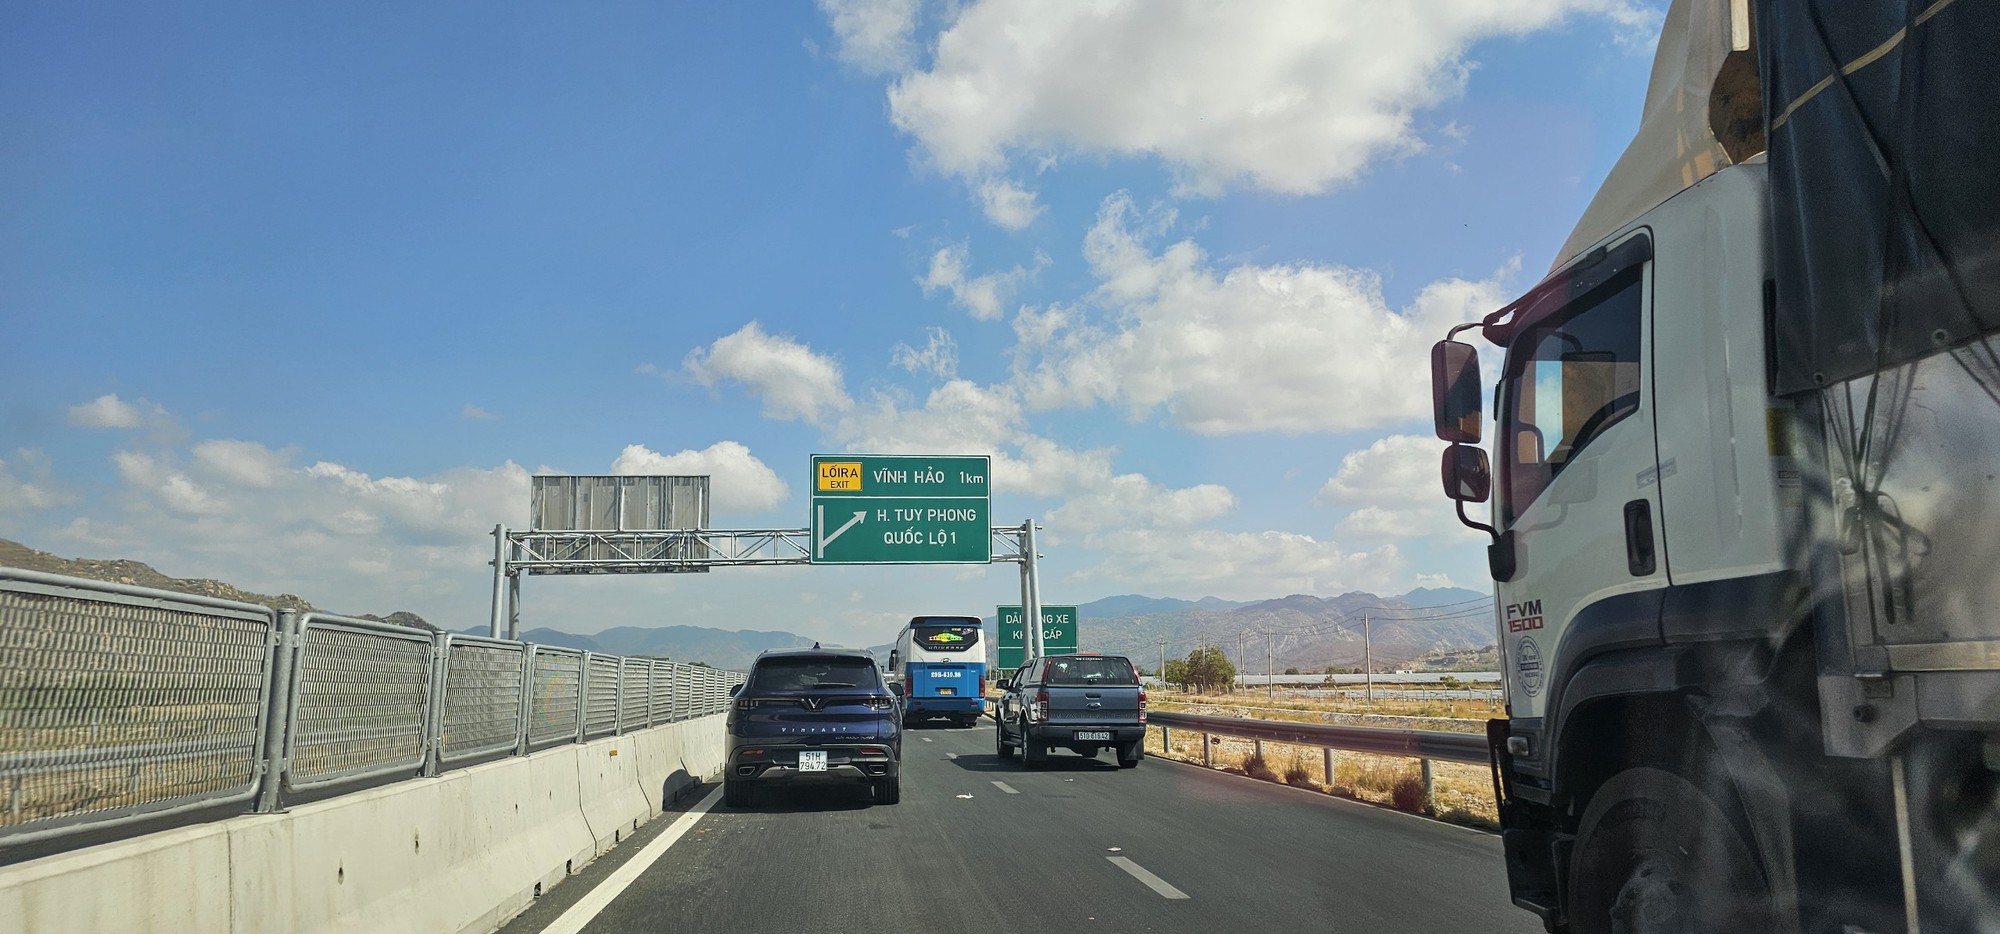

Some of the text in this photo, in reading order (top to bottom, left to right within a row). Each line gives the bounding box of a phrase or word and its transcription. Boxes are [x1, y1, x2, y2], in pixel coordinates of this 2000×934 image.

[873, 466, 945, 484] VĨNH HẢO
[830, 480, 850, 489] EXIT
[877, 509, 977, 522] H. TUY PHONG
[884, 526, 956, 547] QUỐC LỘ 1
[1506, 599, 1542, 619] FVM
[1056, 614, 1069, 624] XE
[1508, 616, 1543, 633] 1500
[1043, 626, 1063, 640] CẤP
[805, 752, 821, 761] 51H
